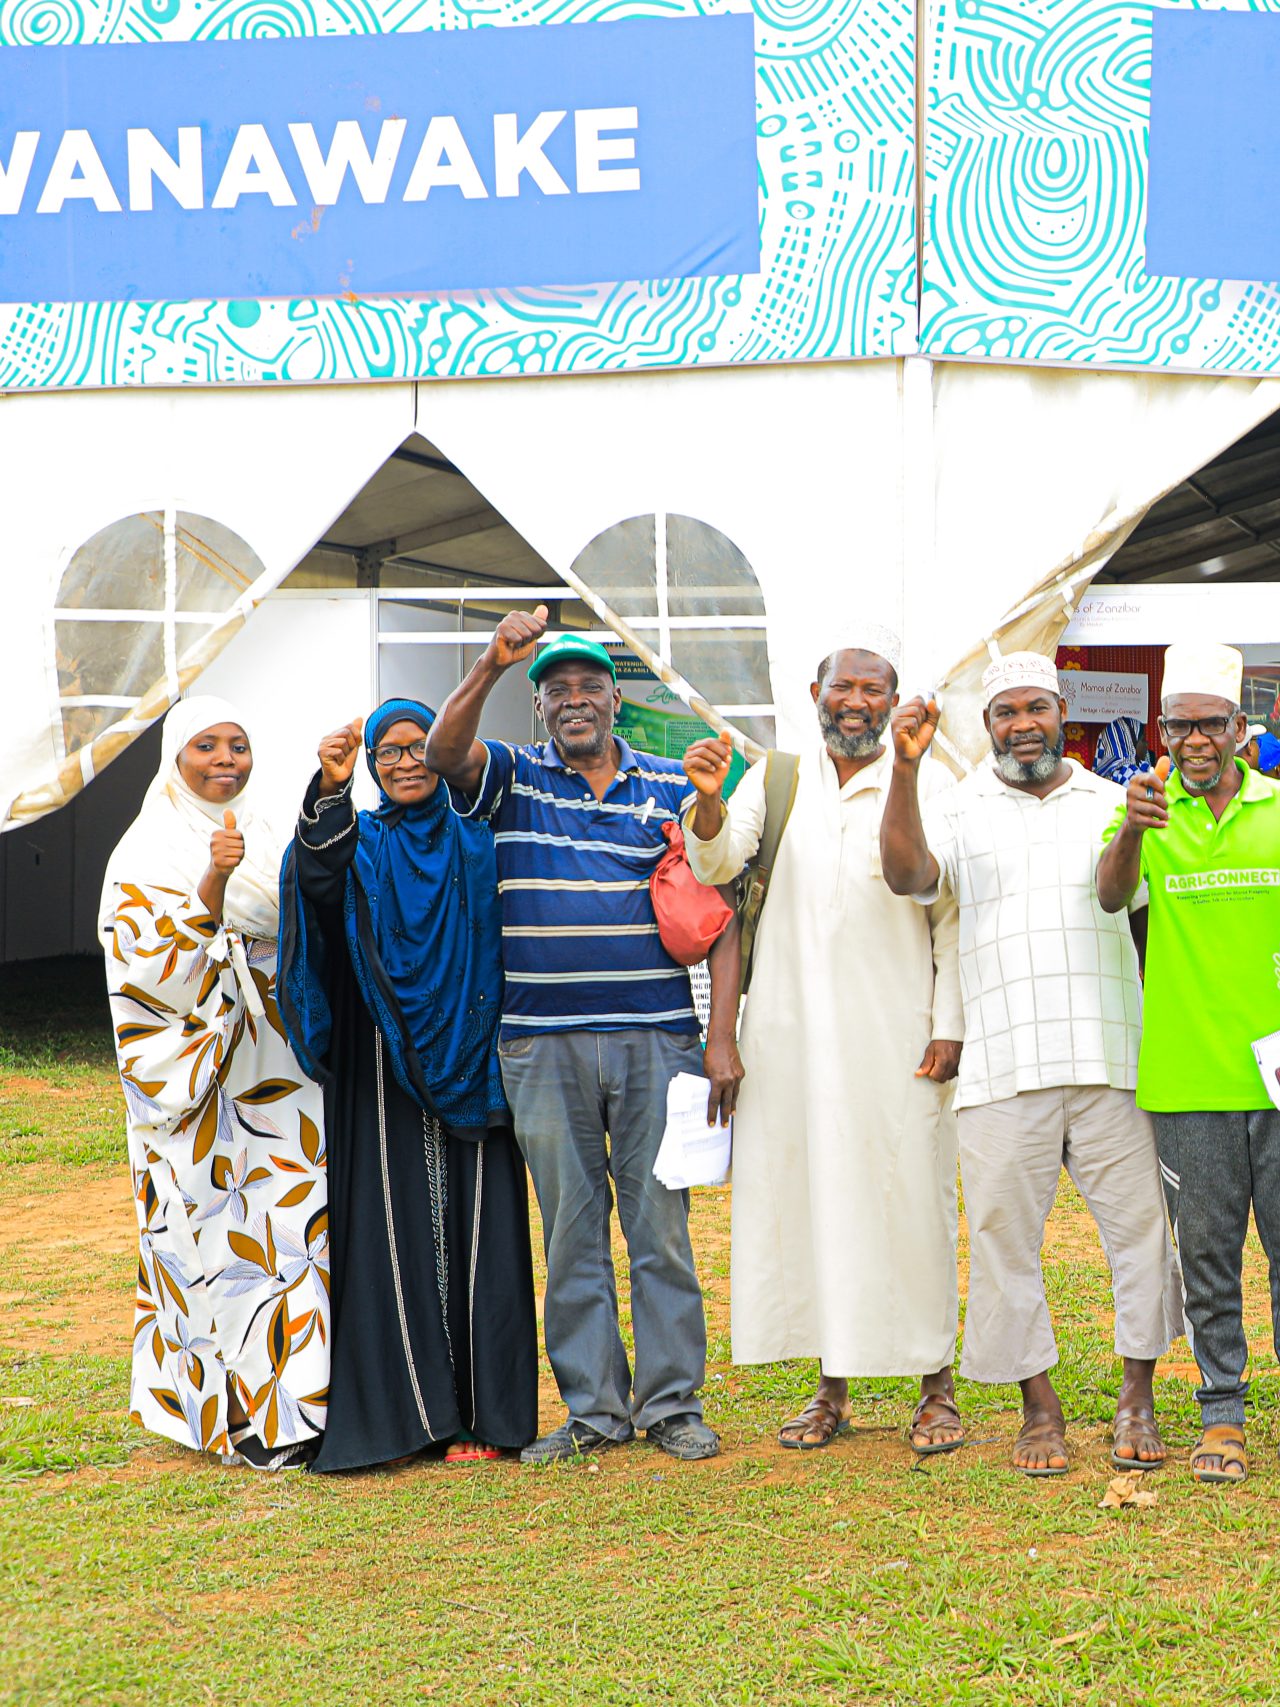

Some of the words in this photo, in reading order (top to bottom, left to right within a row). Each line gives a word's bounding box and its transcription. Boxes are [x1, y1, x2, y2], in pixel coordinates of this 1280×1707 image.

[1096, 601, 1142, 614] Zanzibar
[1080, 682, 1105, 692] Mamas
[1106, 683, 1113, 694] of
[1114, 683, 1142, 694] Zanzibar
[1168, 871, 1279, 889] AGRI-CONNECT
